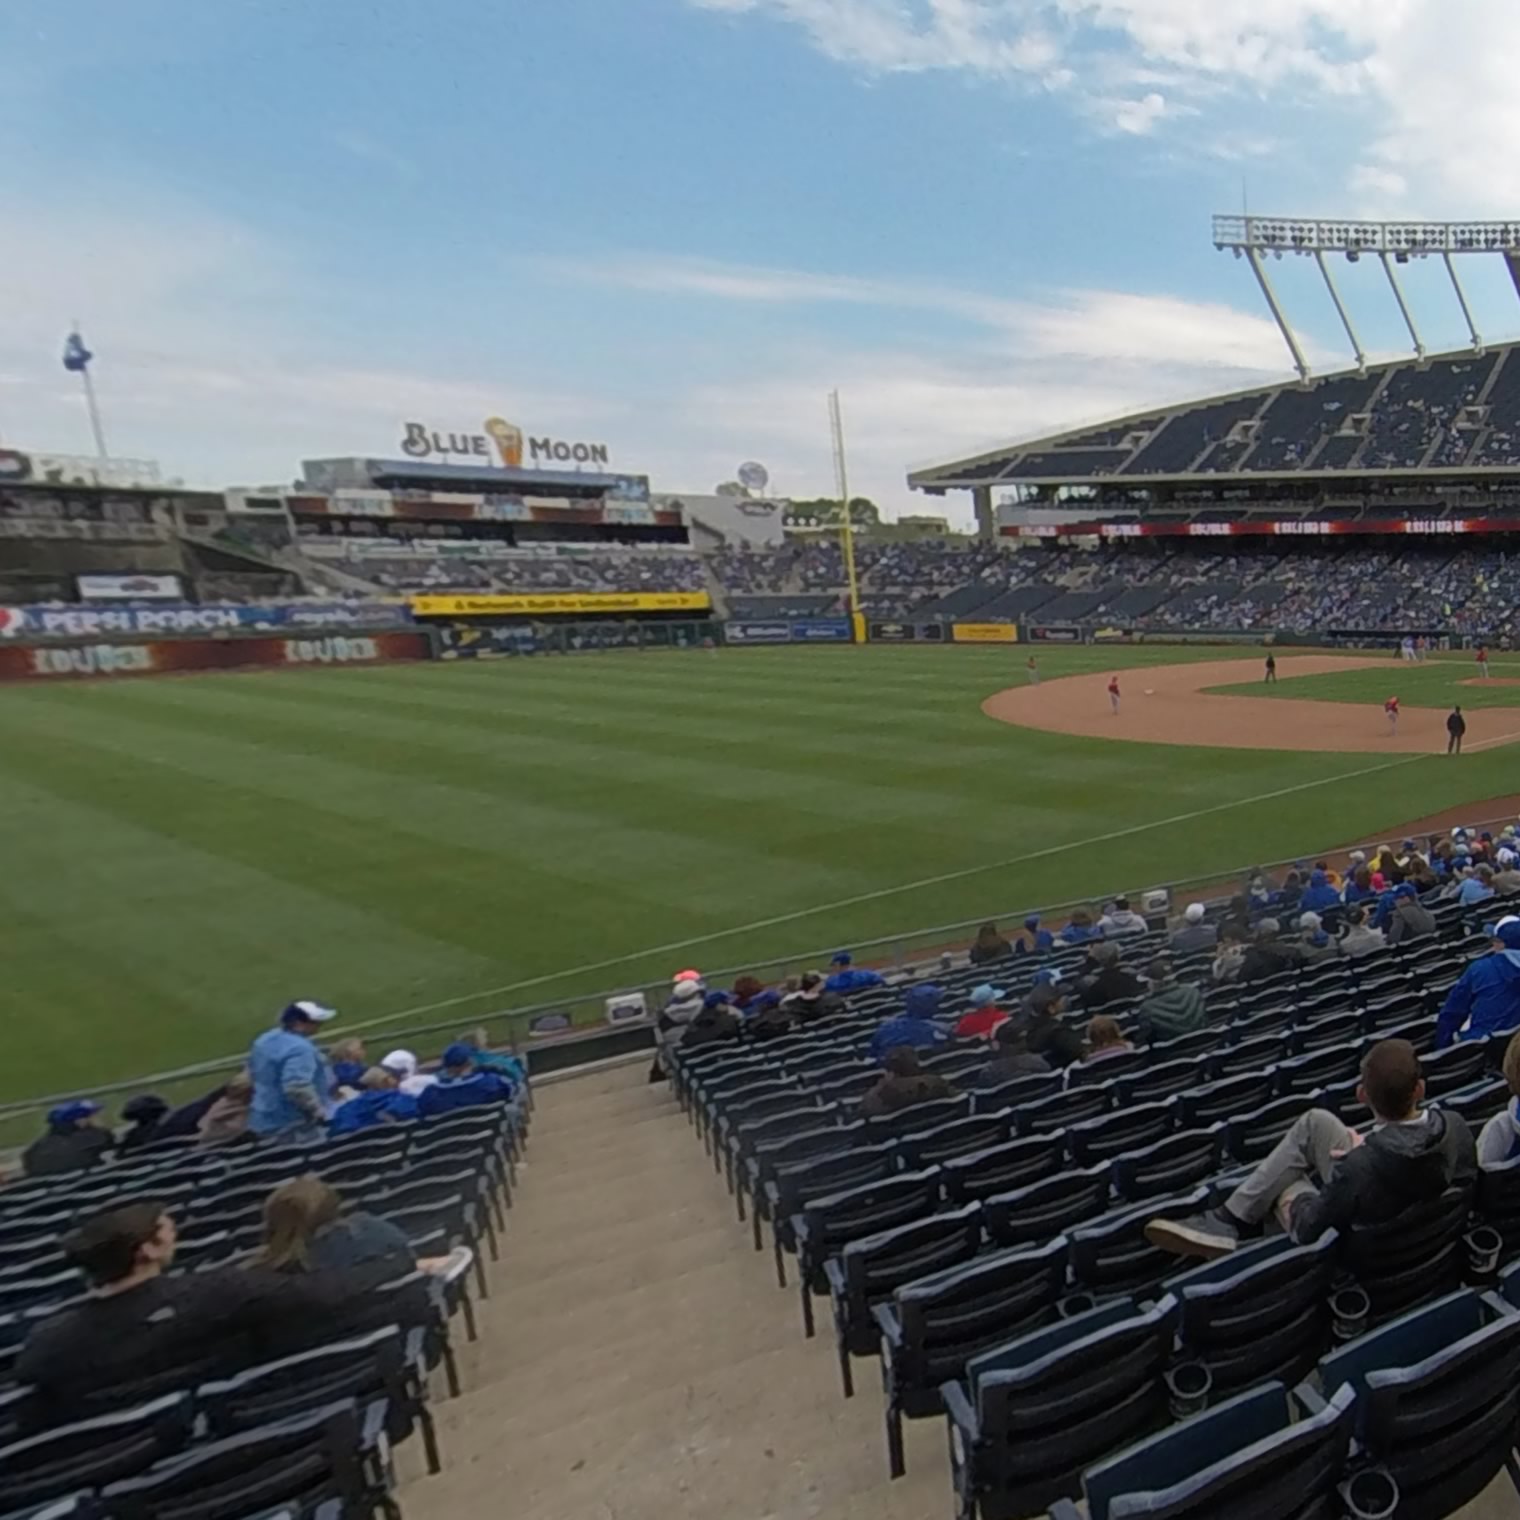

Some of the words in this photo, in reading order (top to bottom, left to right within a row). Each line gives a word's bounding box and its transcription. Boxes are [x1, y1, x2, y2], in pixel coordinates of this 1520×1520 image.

[402, 422, 489, 457] BLUE
[528, 437, 607, 463] MOON
[41, 610, 131, 632] PEPSI
[135, 609, 239, 631] PORCH
